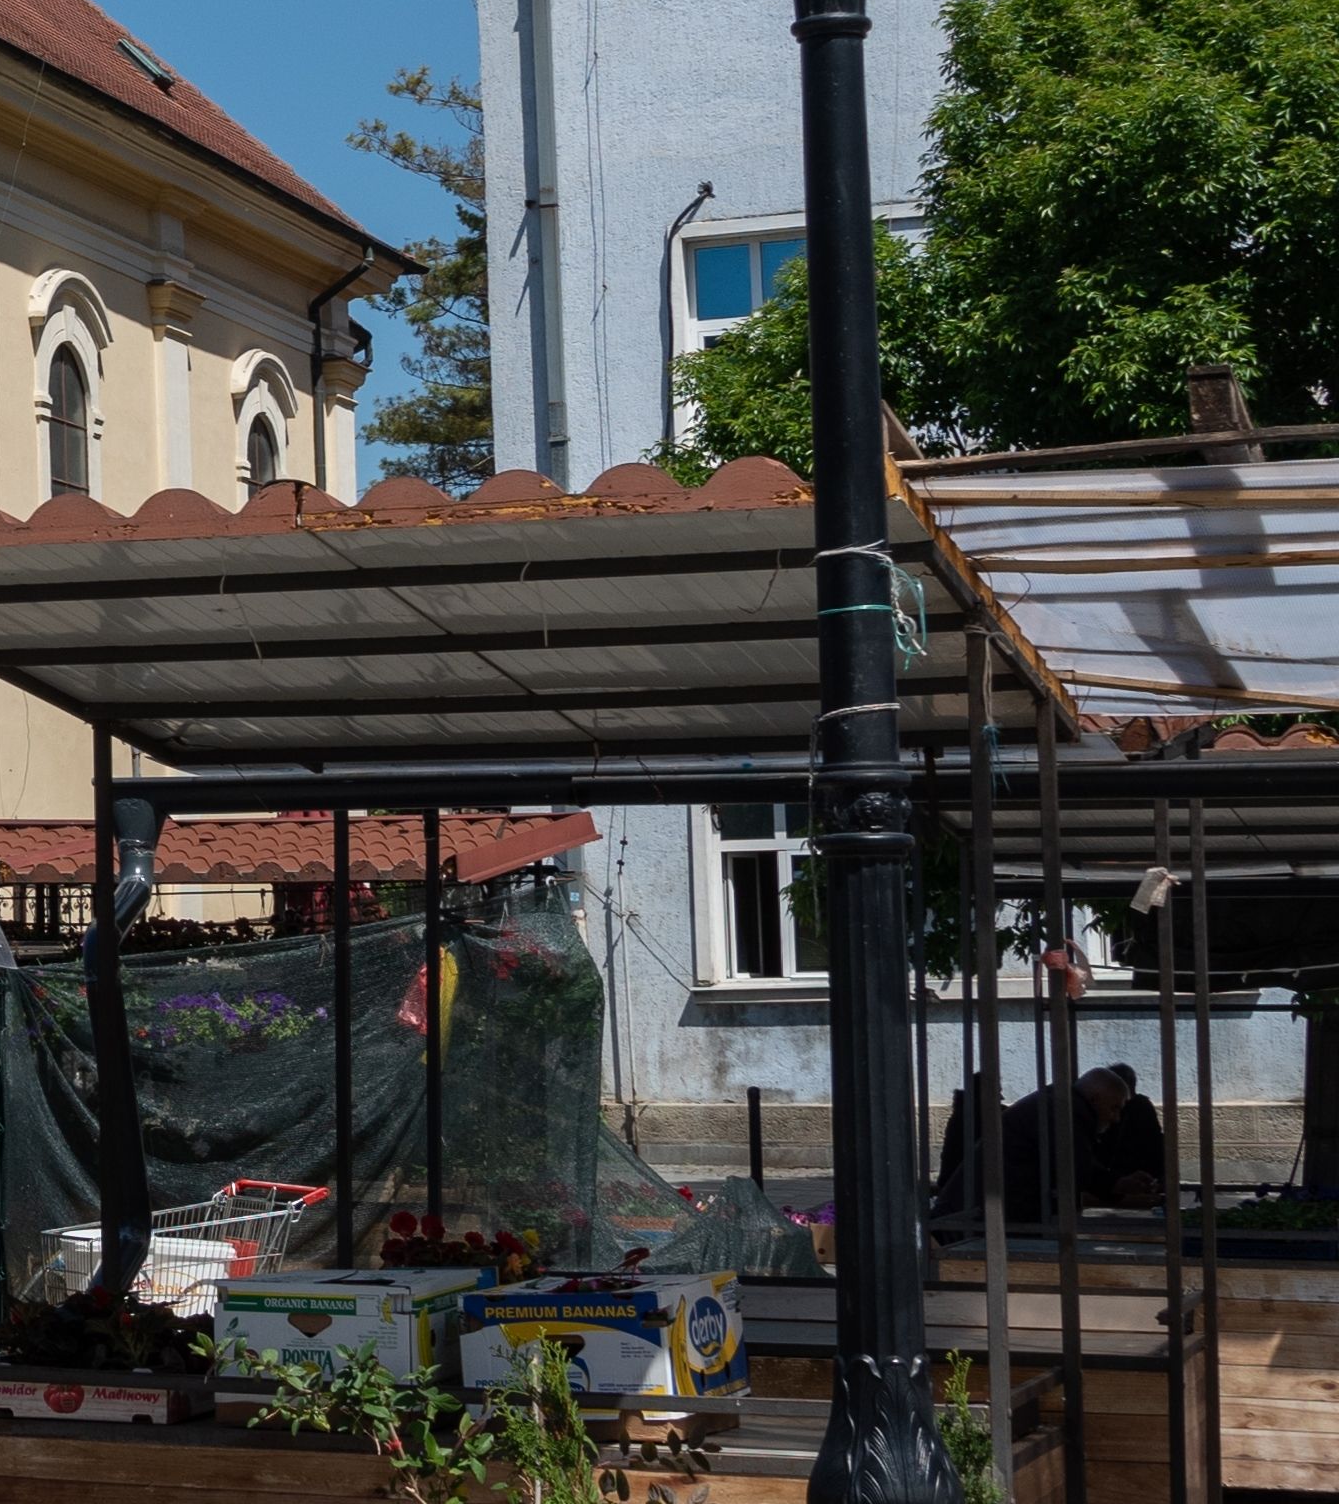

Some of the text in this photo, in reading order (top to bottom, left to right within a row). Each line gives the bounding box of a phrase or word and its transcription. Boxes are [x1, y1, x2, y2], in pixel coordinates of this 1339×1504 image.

[264, 1297, 355, 1311] ORGANIC BANANAS
[484, 1305, 637, 1319] PREMIUM BANANAS
[690, 1306, 724, 1351] derby
[92, 1387, 161, 1404] Malinowy
